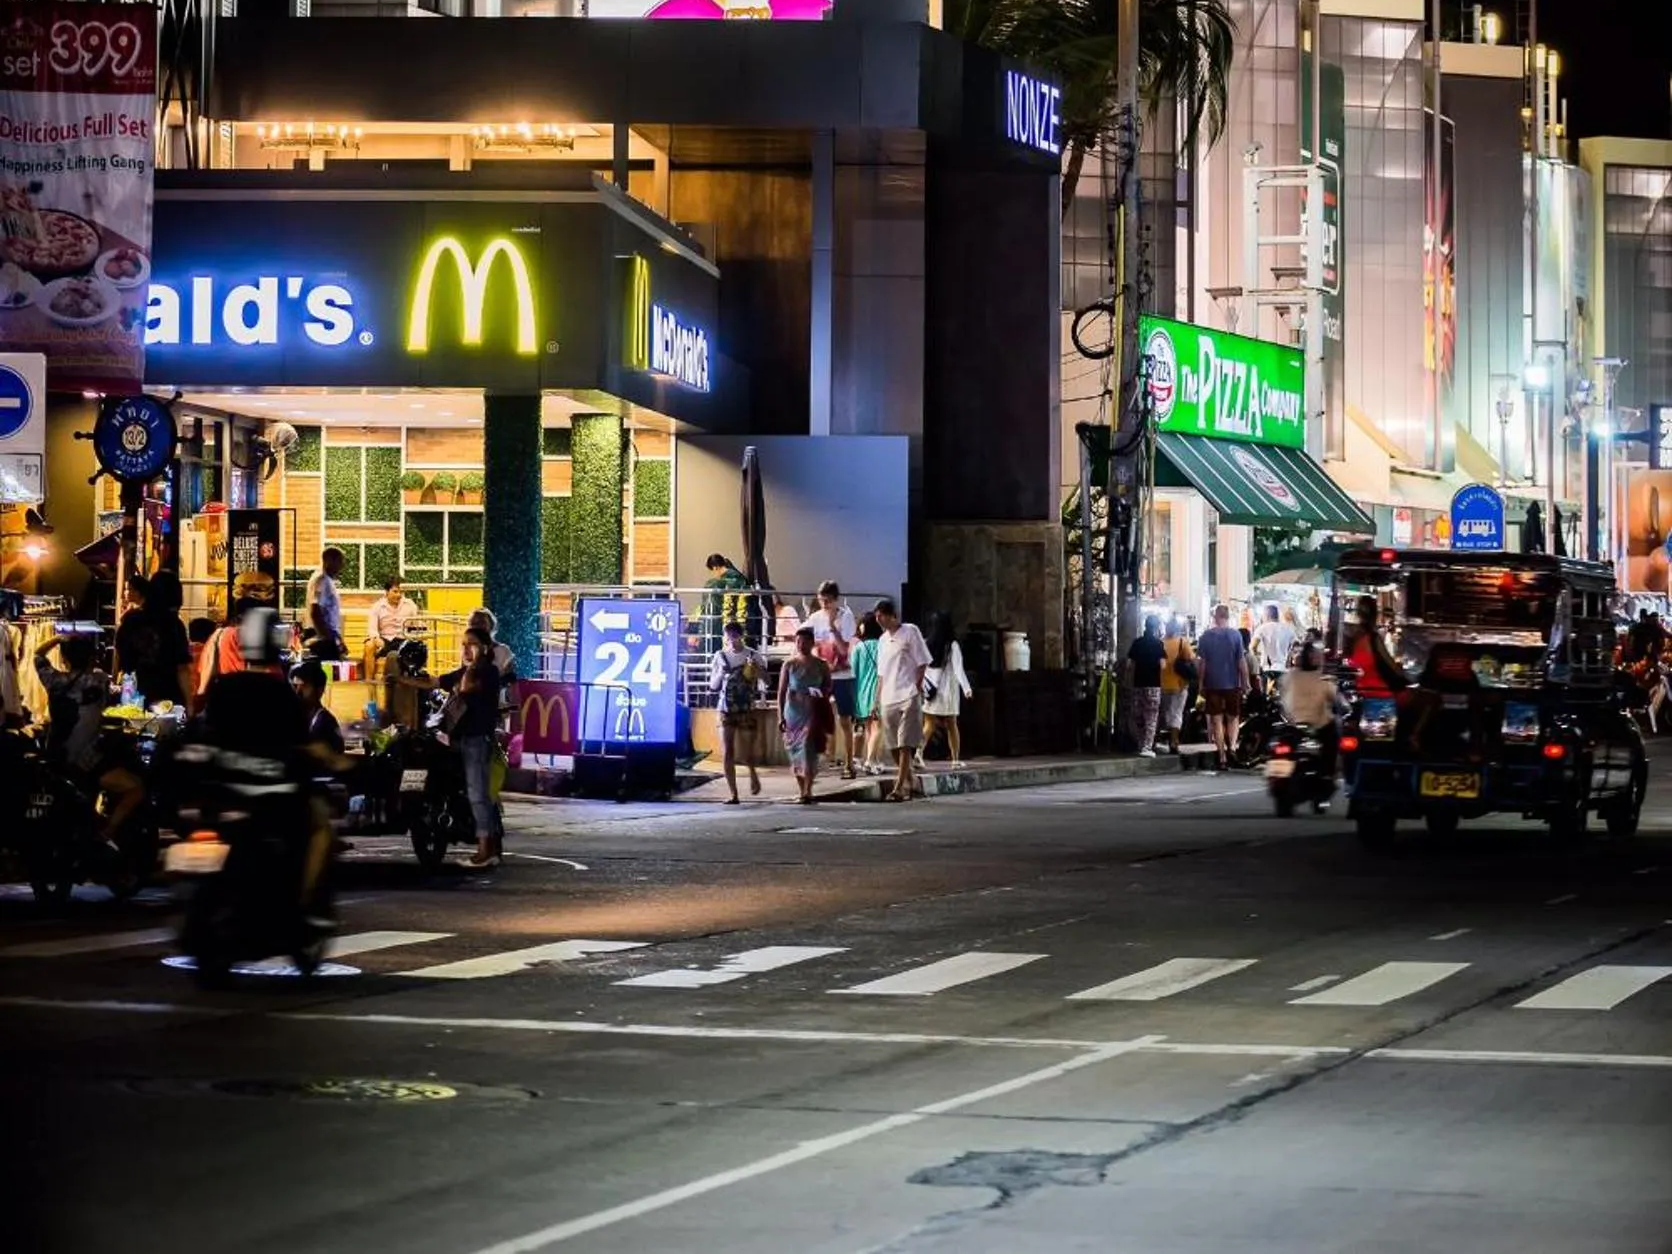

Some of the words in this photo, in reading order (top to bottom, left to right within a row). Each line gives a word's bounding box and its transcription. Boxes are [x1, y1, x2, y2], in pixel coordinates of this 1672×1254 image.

[3, 49, 41, 77] set
[50, 20, 142, 77] 399
[0, 116, 79, 143] Delicious
[84, 112, 113, 138] Full
[118, 113, 148, 139] Set
[1007, 70, 1060, 155] NONZE
[144, 276, 354, 346] ald's
[593, 641, 667, 692] 24
